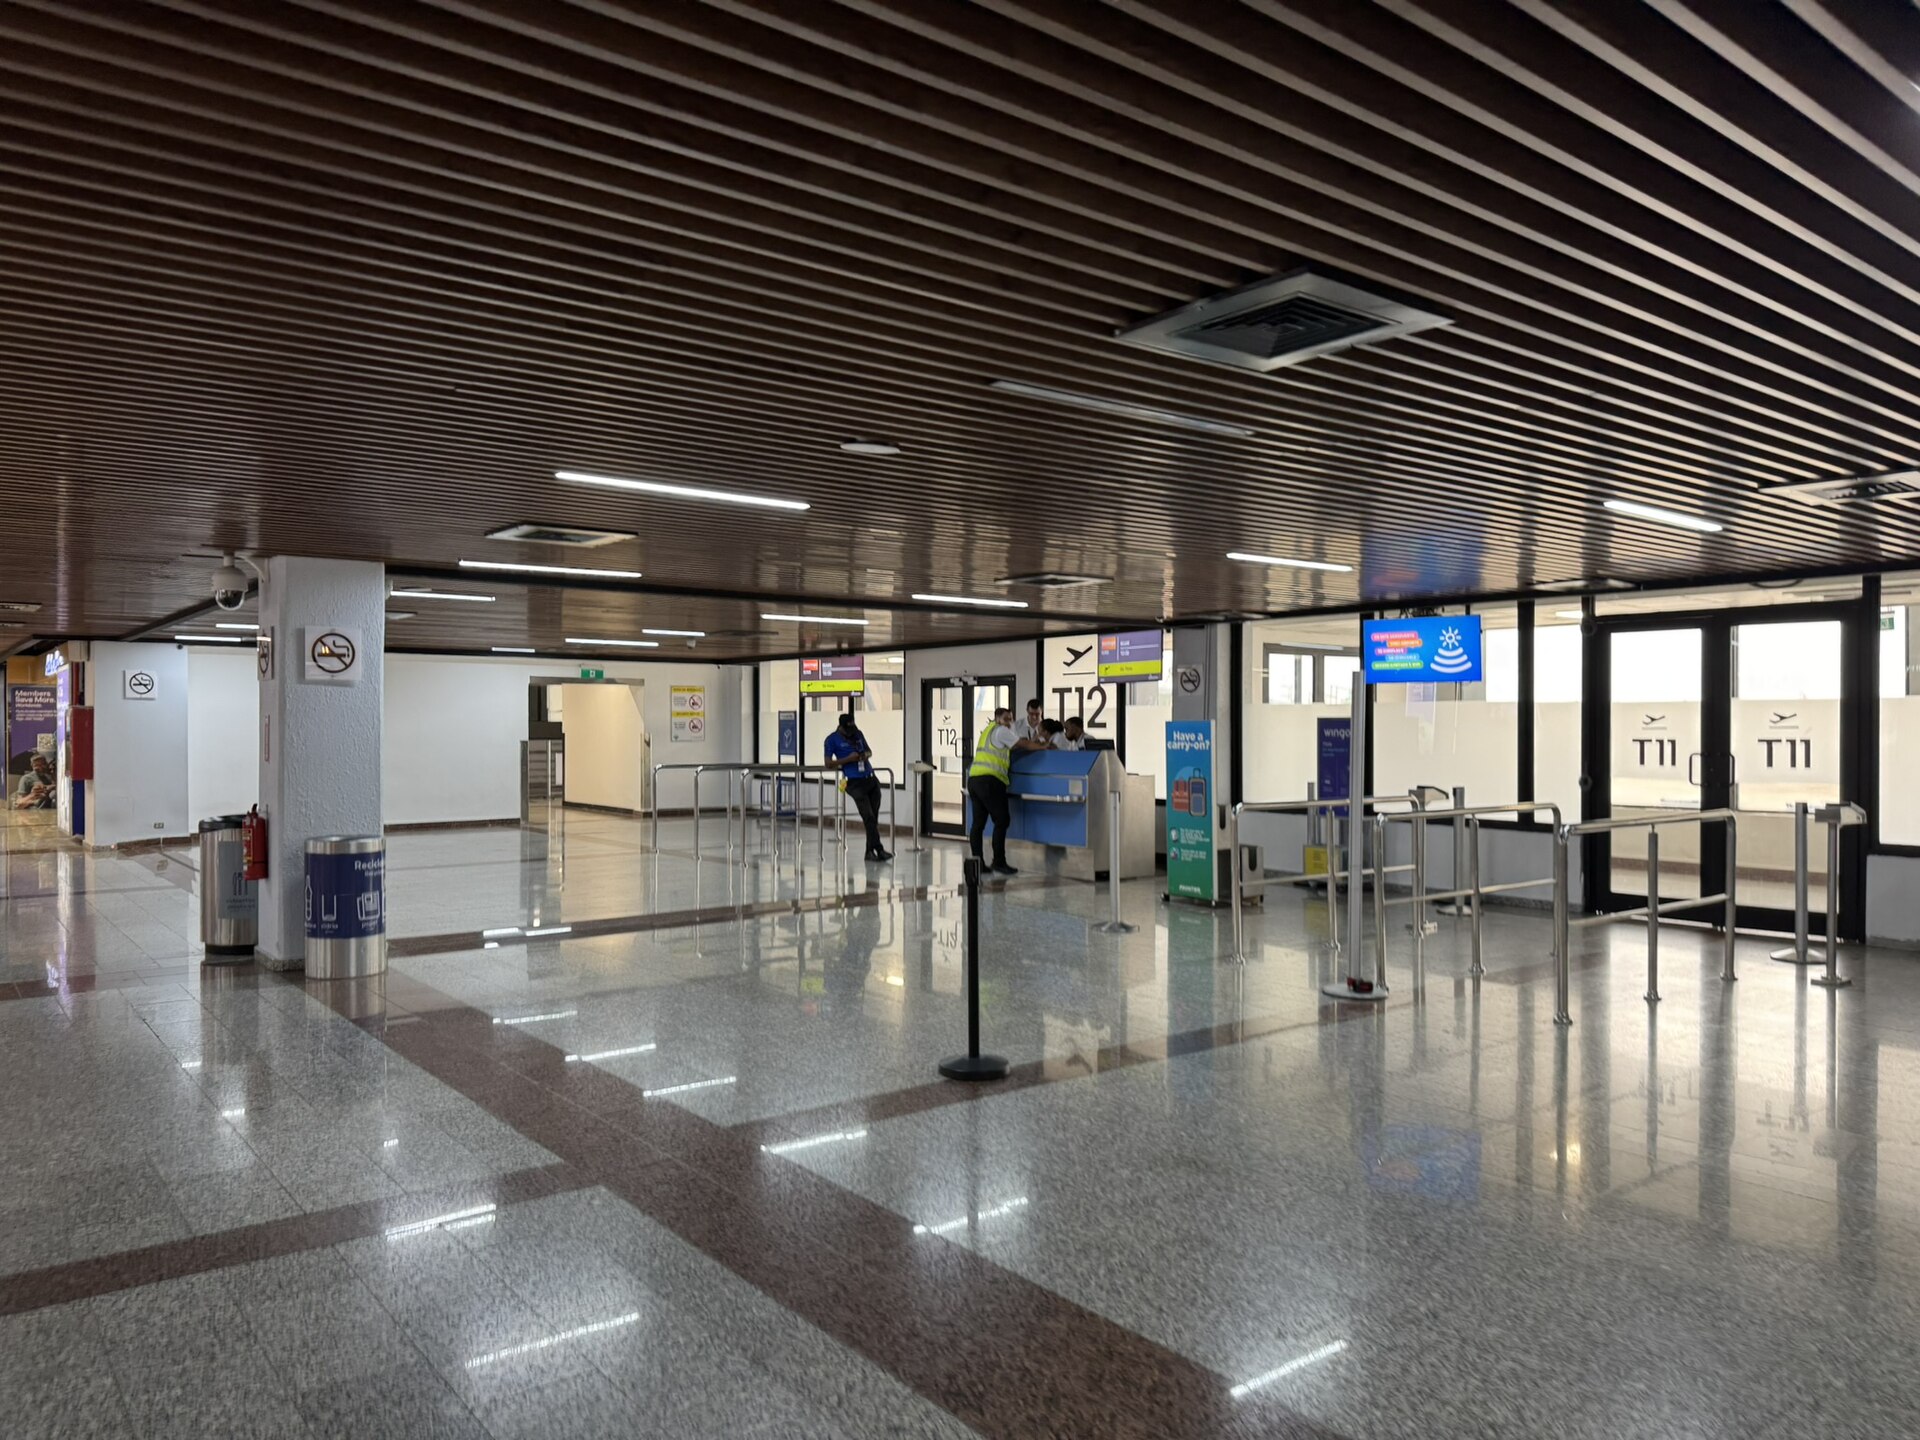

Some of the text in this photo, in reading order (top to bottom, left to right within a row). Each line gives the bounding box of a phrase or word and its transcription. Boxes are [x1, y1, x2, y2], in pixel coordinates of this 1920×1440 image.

[1052, 686, 1107, 729] T12
[937, 728, 957, 747] T12
[1167, 739, 1210, 752] carry-on?
[1173, 730, 1204, 742] Have a
[1632, 738, 1677, 767] T11
[1757, 738, 1811, 769] T11
